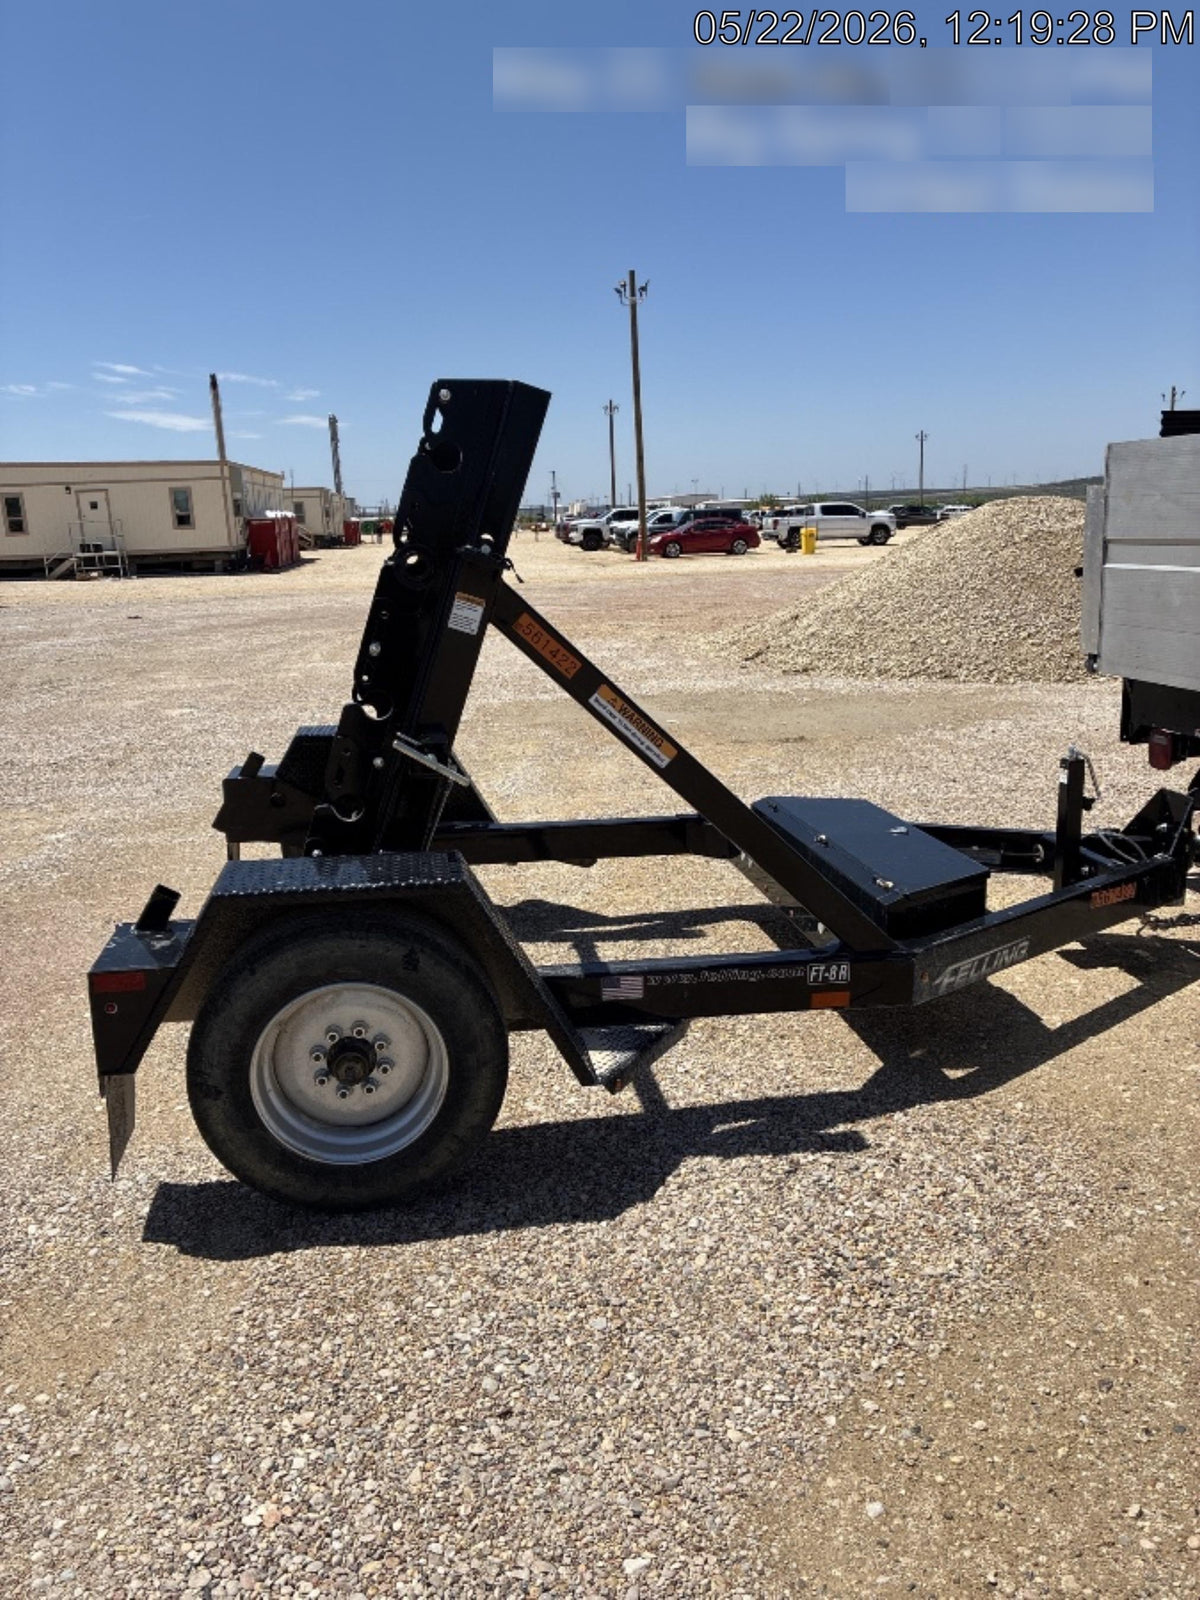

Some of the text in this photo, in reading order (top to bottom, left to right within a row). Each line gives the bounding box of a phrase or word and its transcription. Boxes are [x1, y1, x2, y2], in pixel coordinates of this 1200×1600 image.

[521, 622, 578, 677] 561422
[618, 703, 665, 749] WARNING
[932, 937, 1030, 995] FELLING
